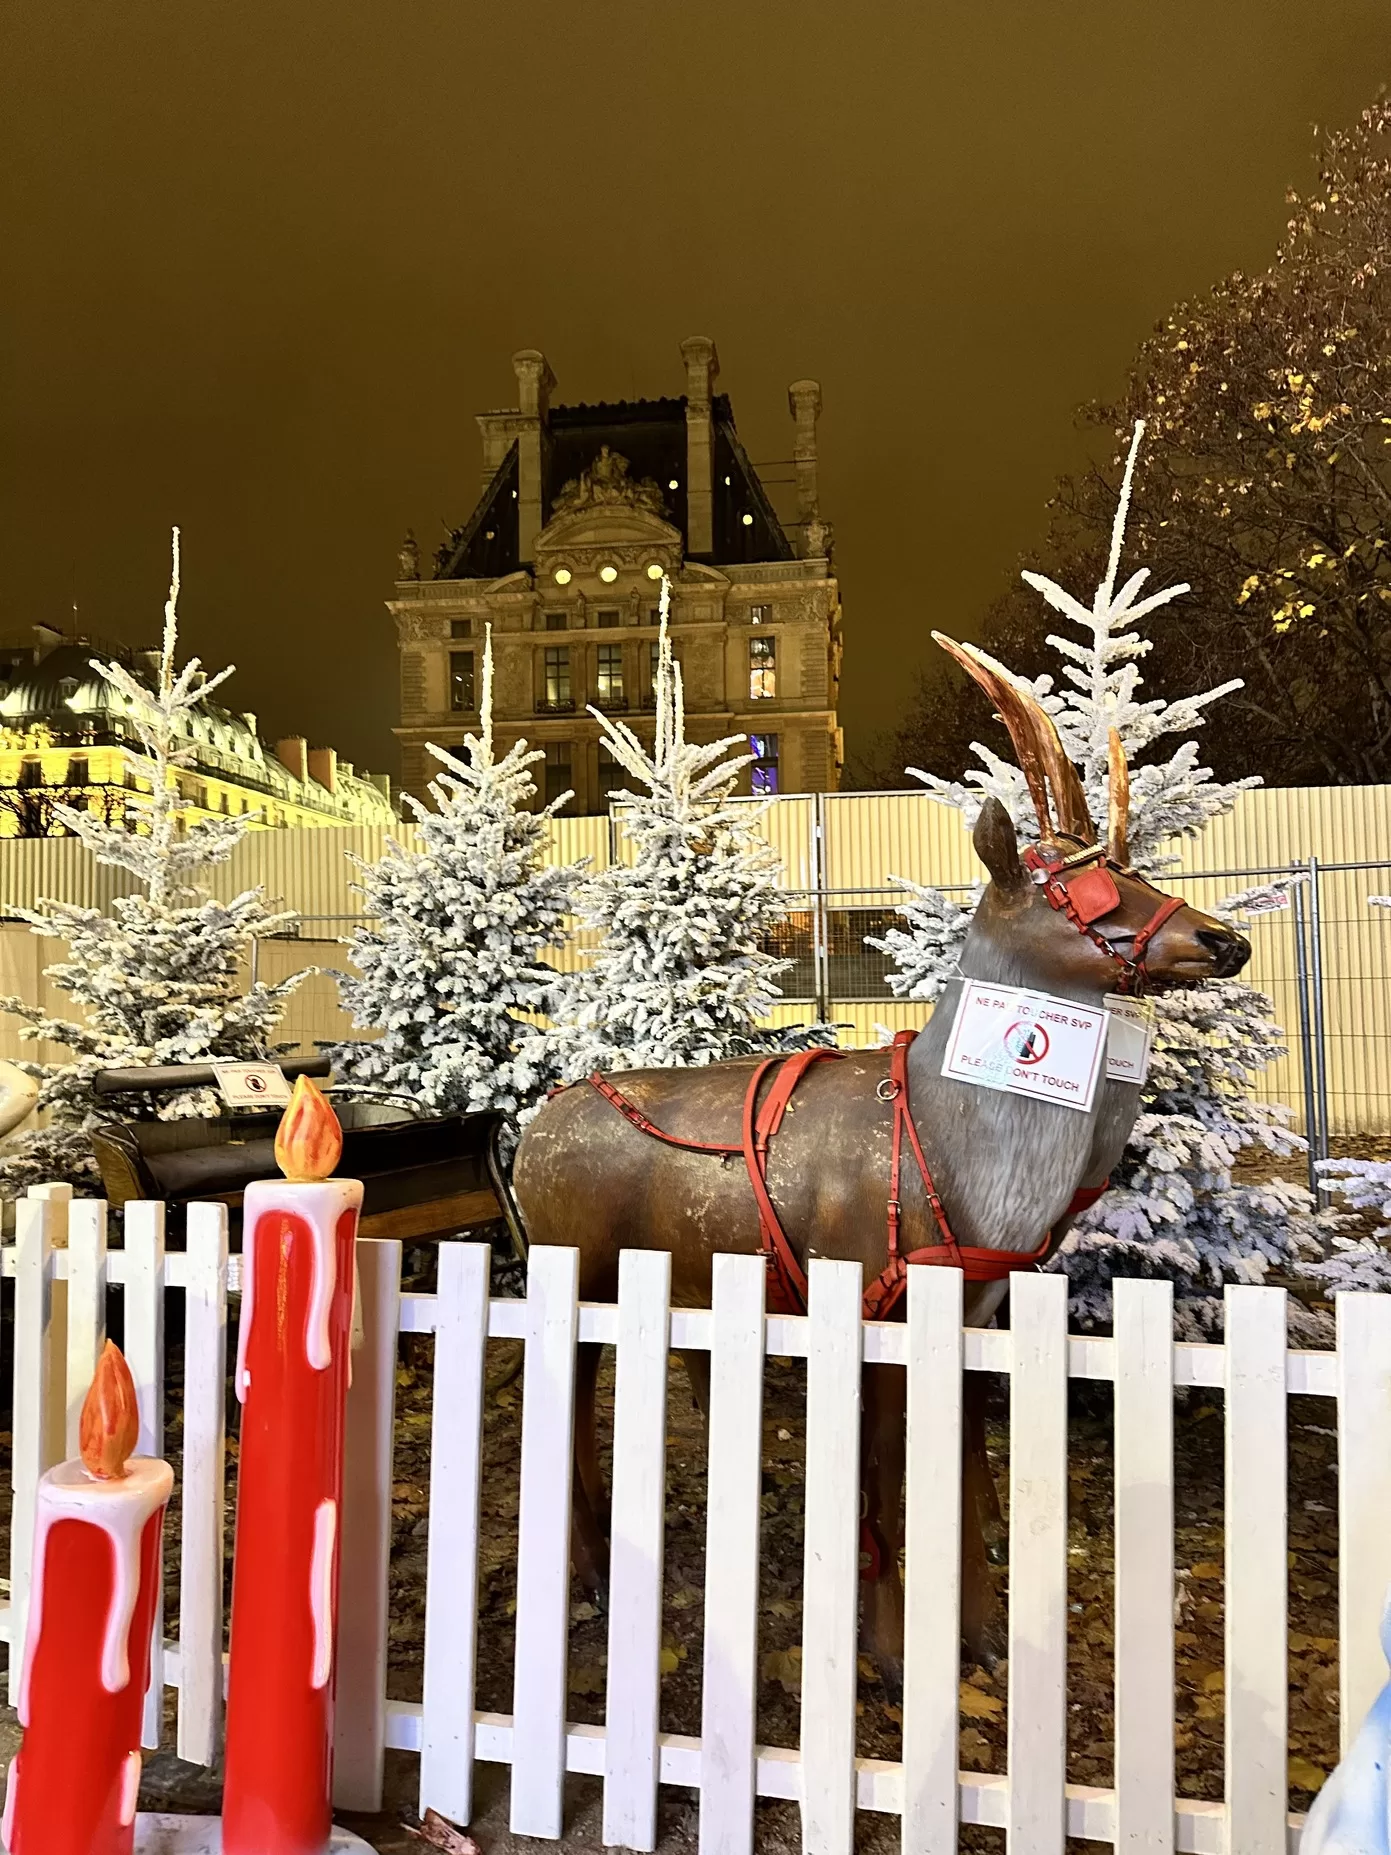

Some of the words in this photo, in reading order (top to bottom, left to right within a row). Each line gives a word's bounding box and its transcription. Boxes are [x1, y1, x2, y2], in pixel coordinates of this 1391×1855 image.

[975, 996, 990, 1007] NE
[992, 999, 1011, 1011] PA
[1070, 1018, 1093, 1030] SVP
[960, 1054, 1003, 1072] PLEASE
[1042, 1074, 1080, 1092] TOUCH
[1107, 1056, 1134, 1069] OUCH
